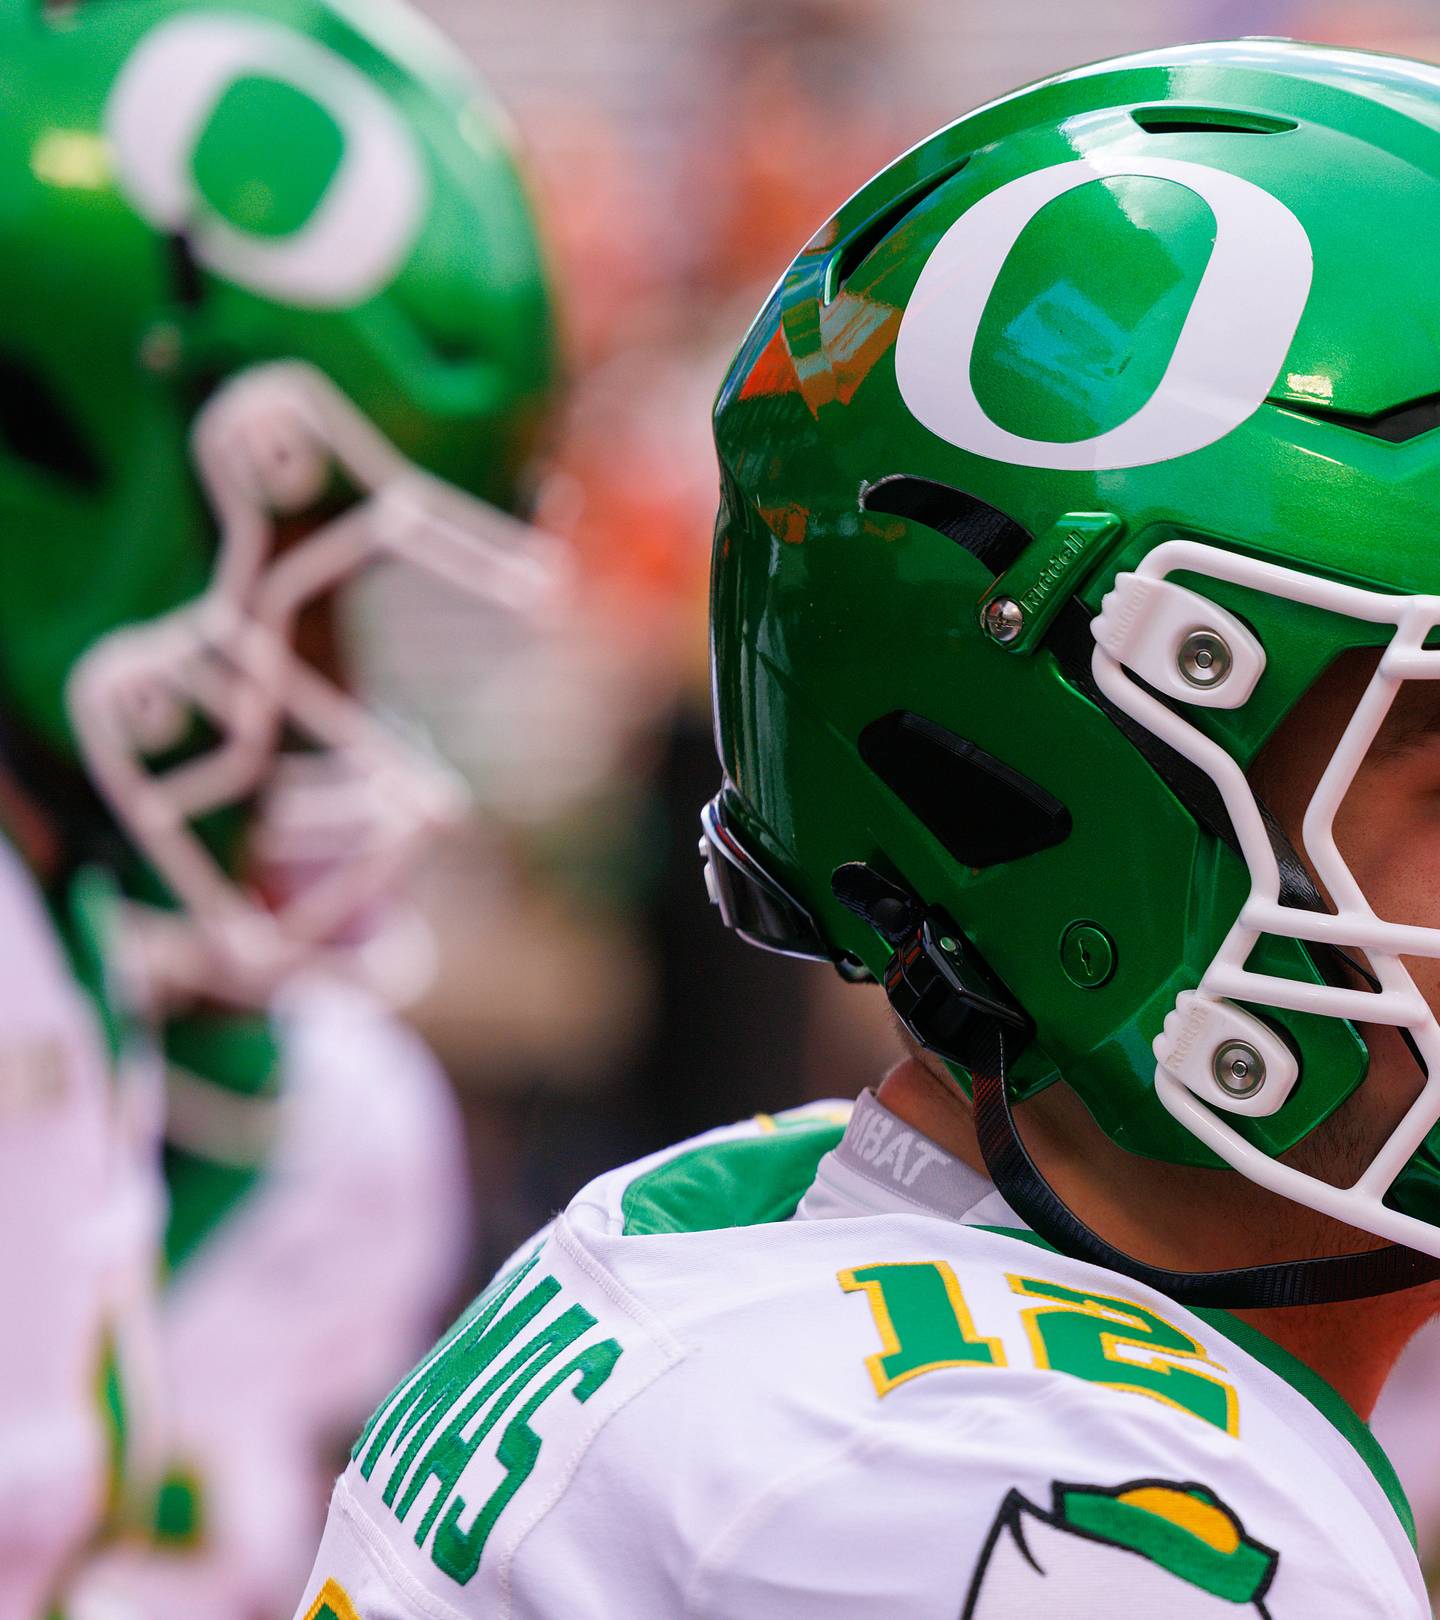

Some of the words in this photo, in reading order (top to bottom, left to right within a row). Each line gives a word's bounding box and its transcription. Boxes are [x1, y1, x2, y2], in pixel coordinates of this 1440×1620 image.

[105, 8, 430, 312] O
[894, 155, 1314, 472] O
[1019, 529, 1086, 614] Riddell
[350, 1237, 624, 1587] MAS
[836, 1260, 1240, 1439] 12
